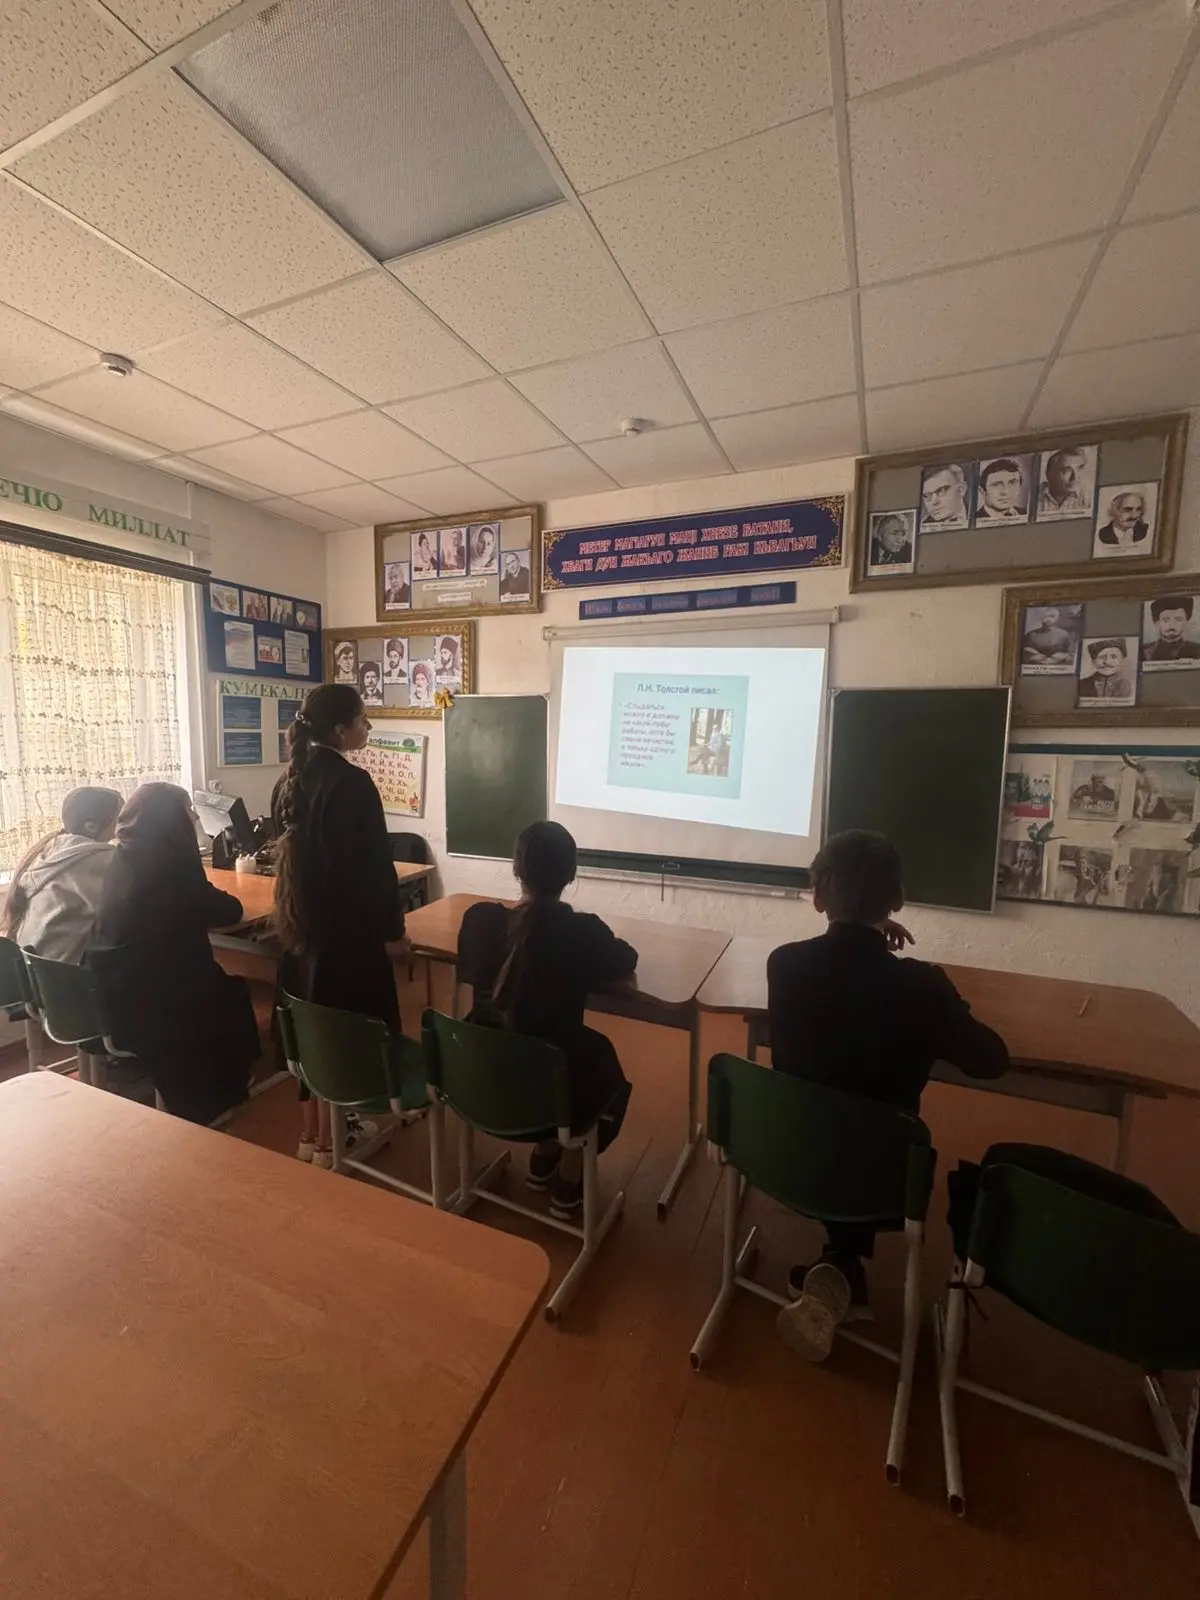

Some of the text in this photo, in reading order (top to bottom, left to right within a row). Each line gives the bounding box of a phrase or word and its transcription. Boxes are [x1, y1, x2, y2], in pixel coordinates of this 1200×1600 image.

[88, 504, 191, 547] МИЛЛАТ
[637, 683, 720, 695] Л.Н. Толстой писал:
